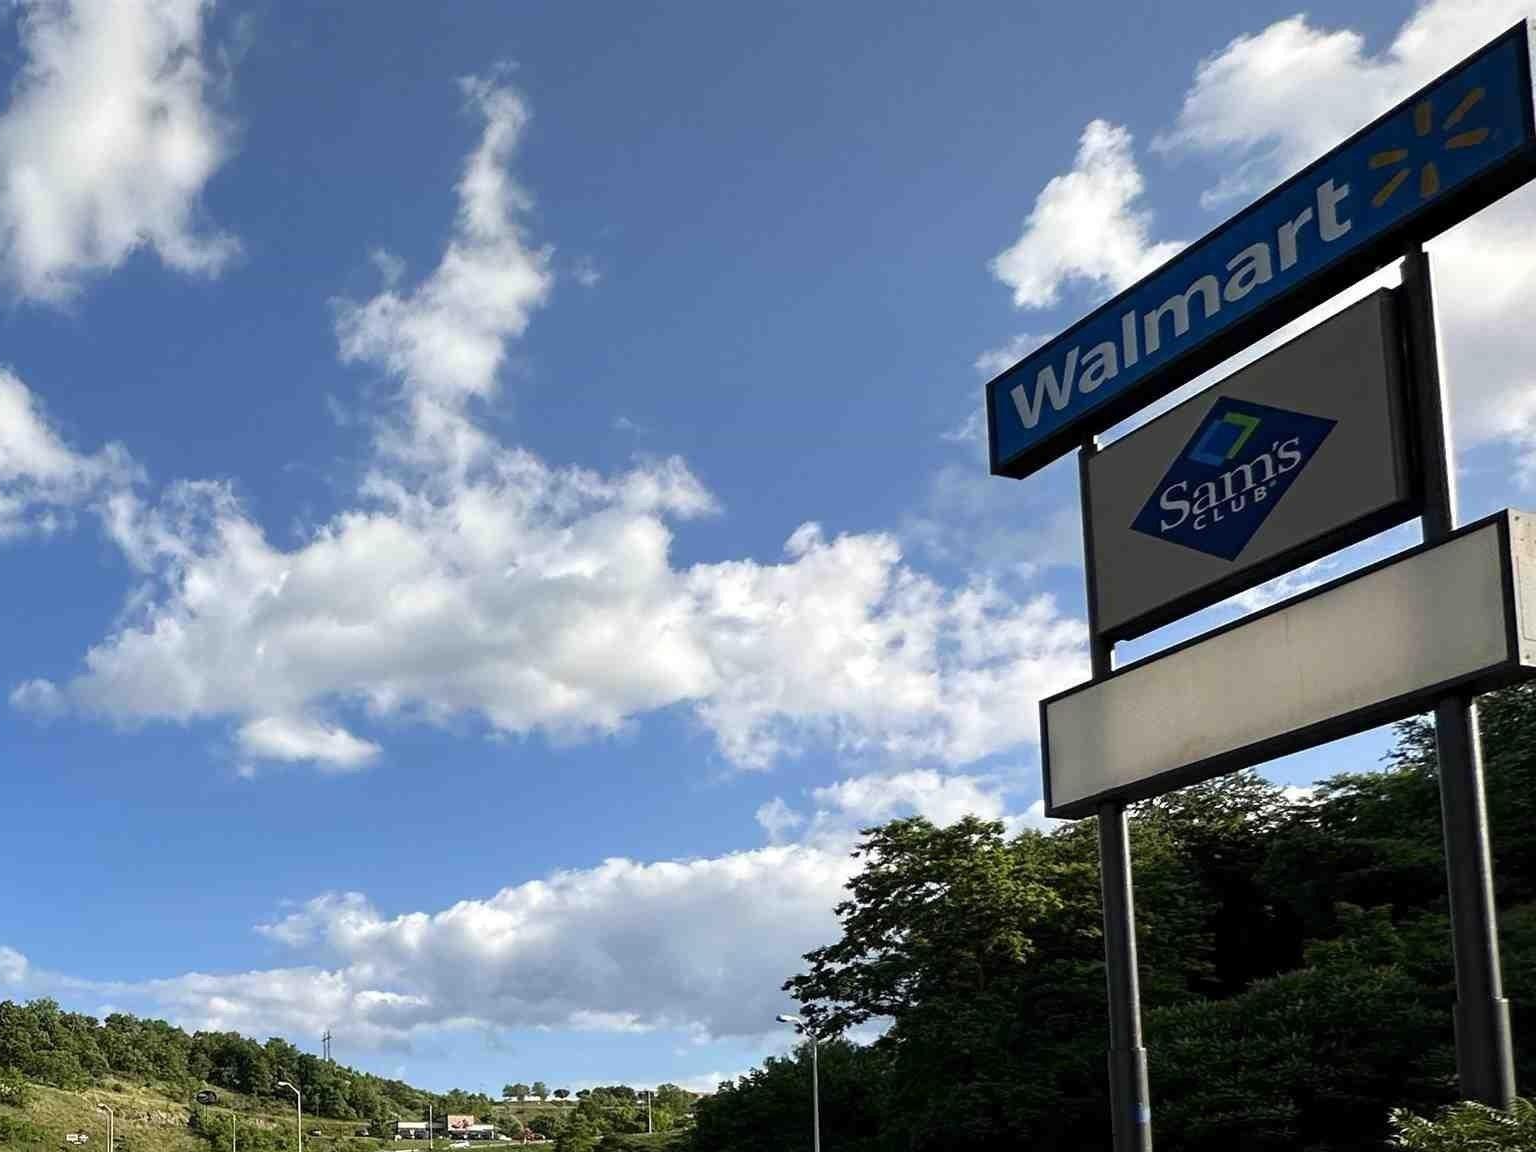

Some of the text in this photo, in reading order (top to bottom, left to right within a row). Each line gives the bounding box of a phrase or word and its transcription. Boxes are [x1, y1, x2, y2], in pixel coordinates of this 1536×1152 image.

[1010, 178, 1352, 429] Walmart
[1159, 437, 1302, 532] Sam's
[1193, 486, 1268, 530] CLUB
